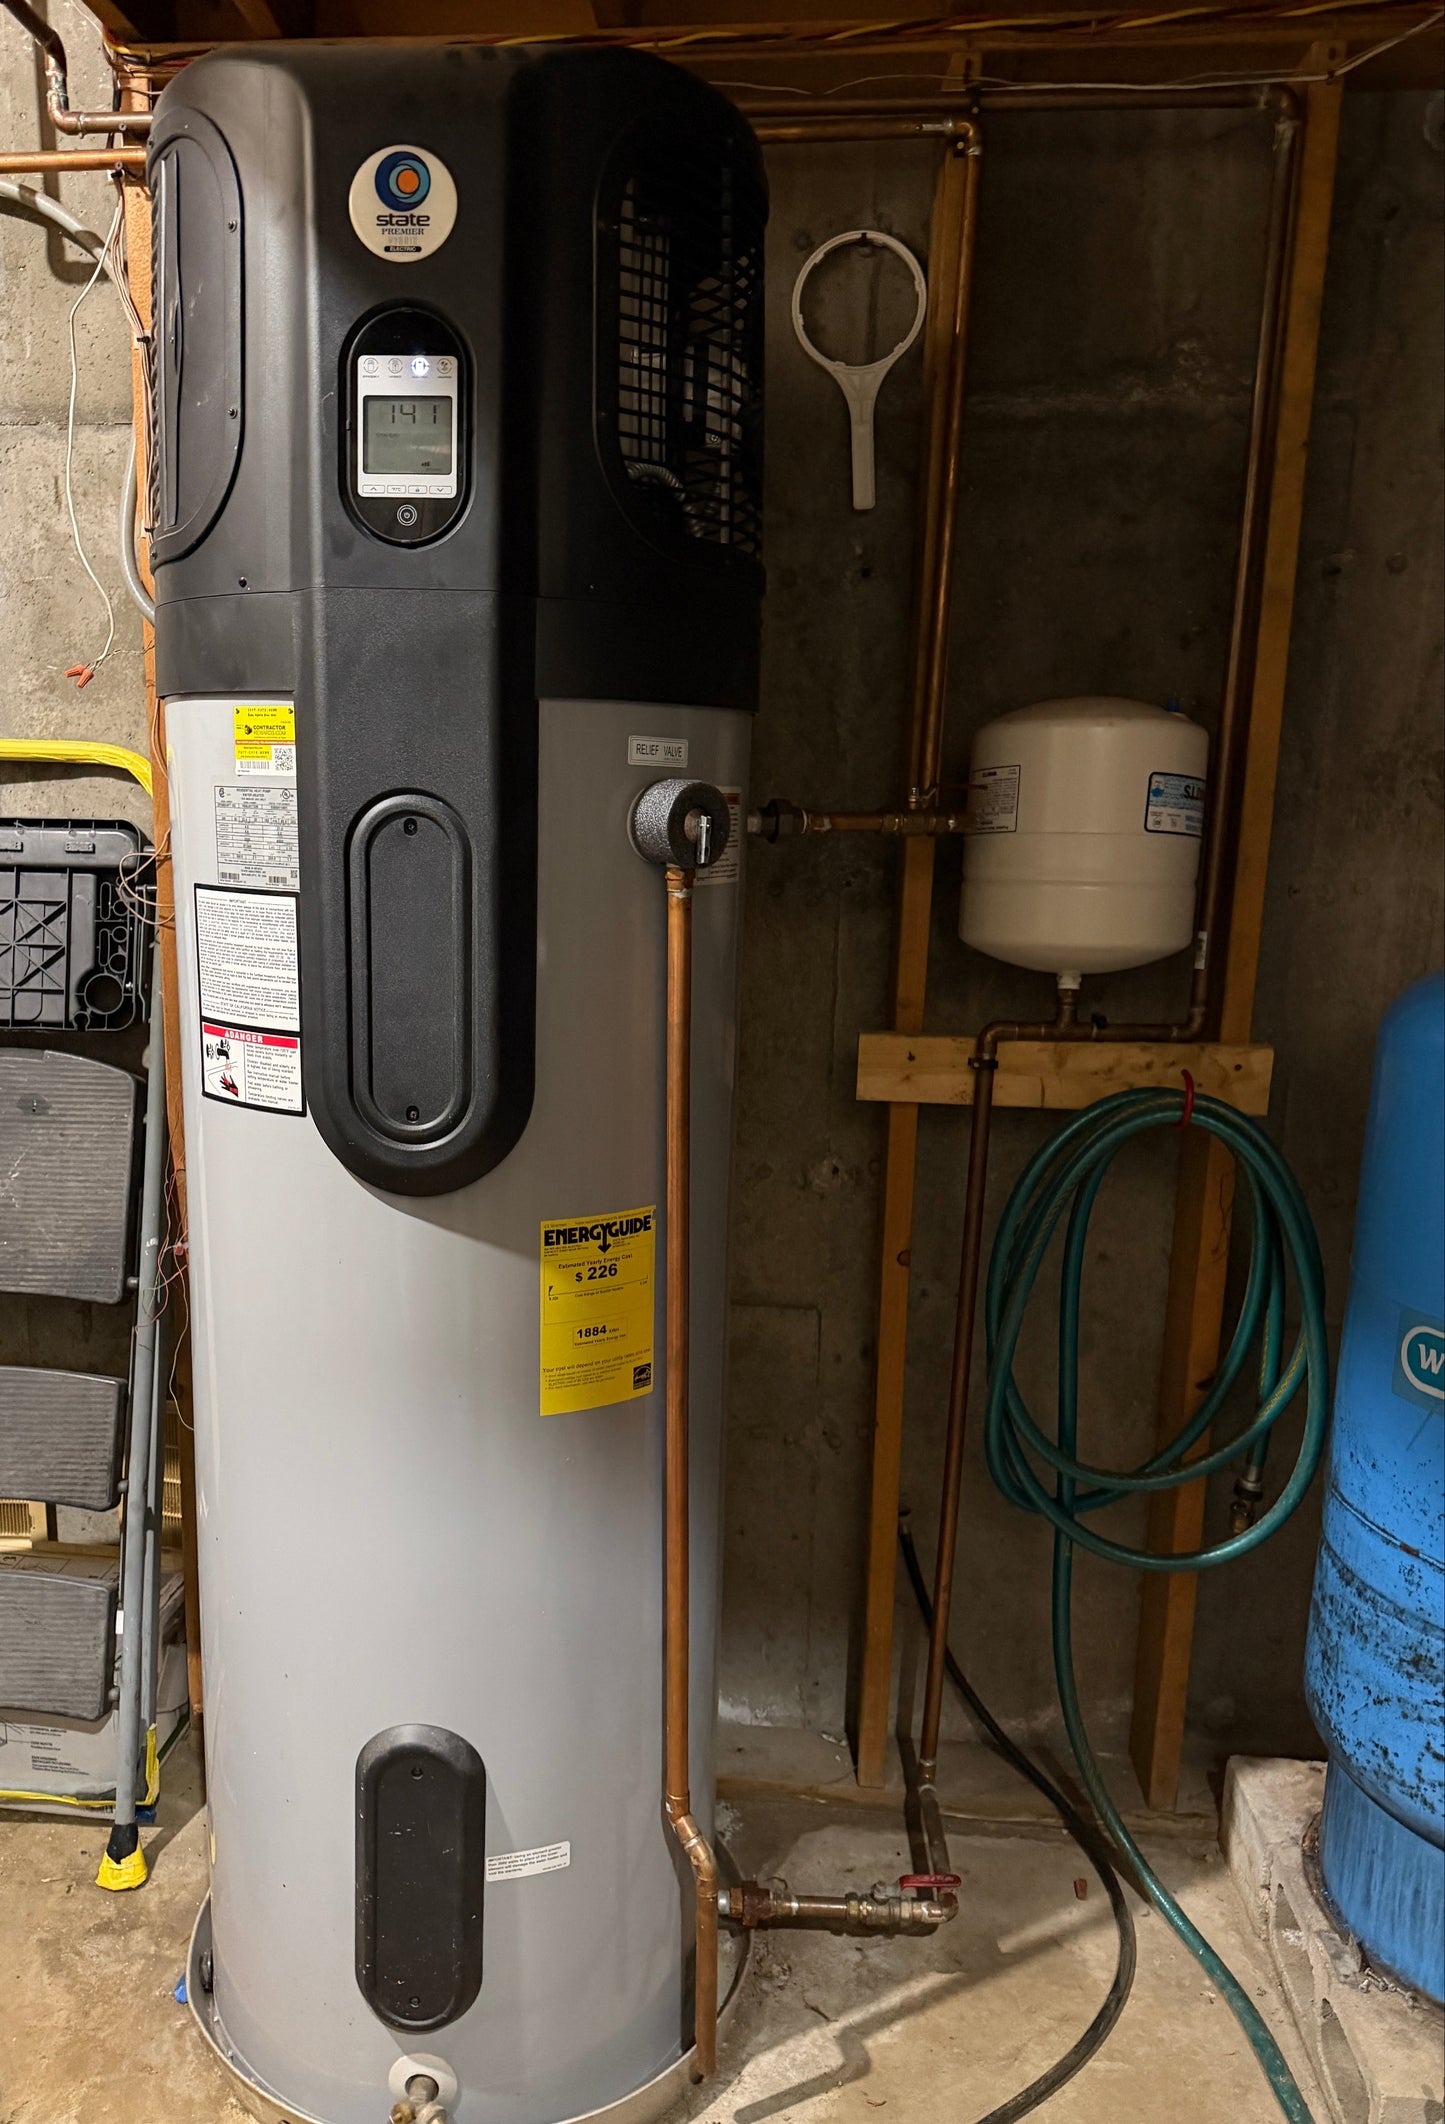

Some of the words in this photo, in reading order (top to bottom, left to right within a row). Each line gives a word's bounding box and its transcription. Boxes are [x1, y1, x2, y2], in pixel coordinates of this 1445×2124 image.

[376, 213, 430, 226] state
[391, 404, 437, 424] 141
[636, 743, 659, 755] RELIEF
[663, 746, 682, 758] VALVE
[230, 1031, 263, 1043] DANGER
[544, 1215, 651, 1250] ENERGYGUIDE
[558, 1261, 585, 1269] Estimated
[603, 1255, 620, 1264] Energy
[575, 1272, 583, 1283] $
[587, 1263, 618, 1281] 226
[577, 1325, 607, 1339] 1884
[576, 1361, 594, 1369] depend
